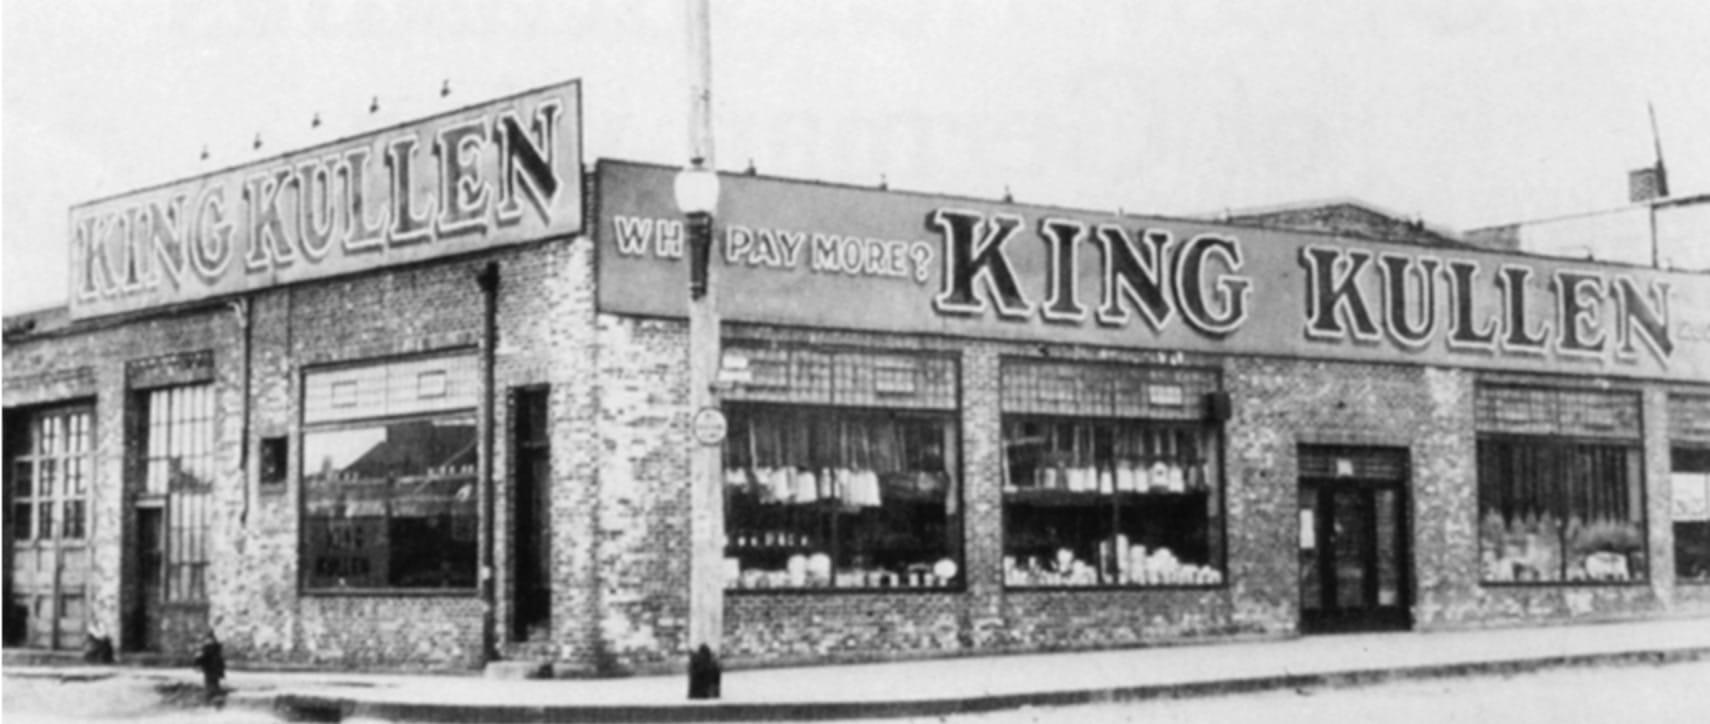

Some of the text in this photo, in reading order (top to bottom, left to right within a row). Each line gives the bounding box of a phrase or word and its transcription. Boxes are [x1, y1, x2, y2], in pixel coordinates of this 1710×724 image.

[77, 99, 562, 299] KING KULLEN
[613, 215, 684, 259] WH
[723, 224, 805, 268] PAY
[809, 232, 933, 284] MORE?
[928, 207, 1252, 337] KING
[1300, 243, 1675, 371] KULLEN
